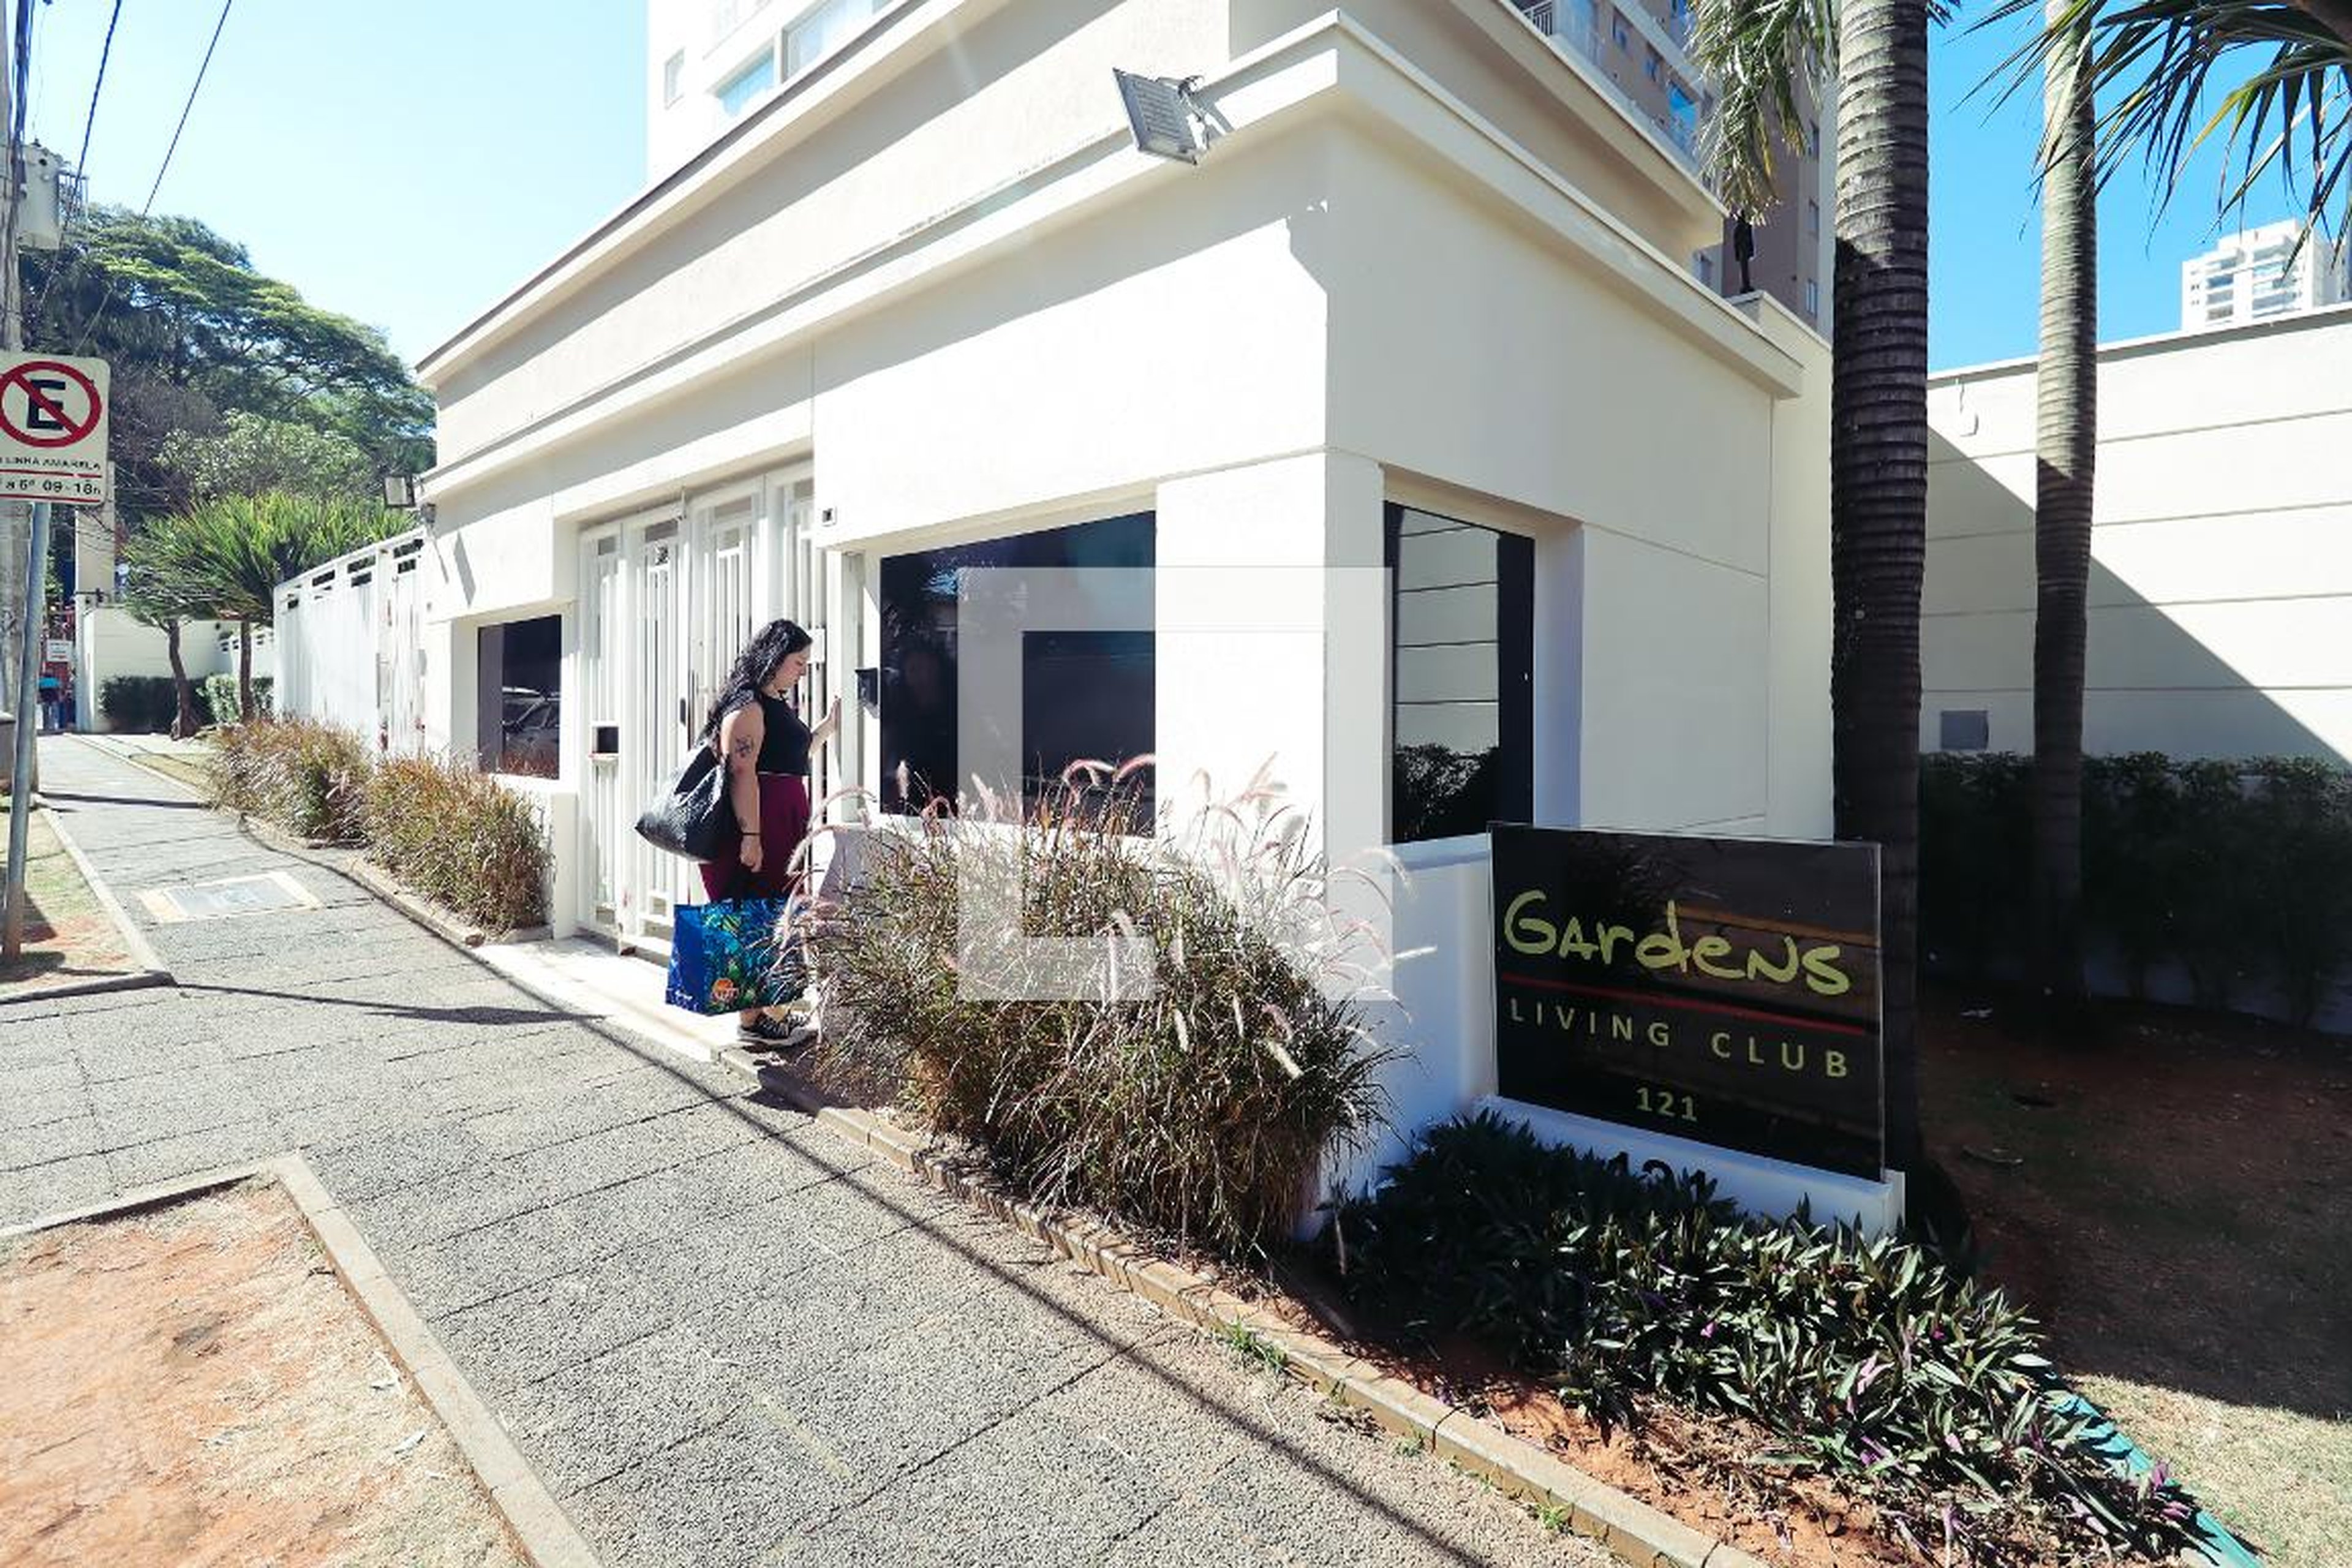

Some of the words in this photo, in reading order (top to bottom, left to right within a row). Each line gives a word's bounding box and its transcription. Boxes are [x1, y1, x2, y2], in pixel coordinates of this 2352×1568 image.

[28, 379, 66, 430] E
[1510, 997, 1670, 1047] LIVING
[1711, 1031, 1848, 1078] CLUB
[1635, 1087, 1699, 1123] 121
